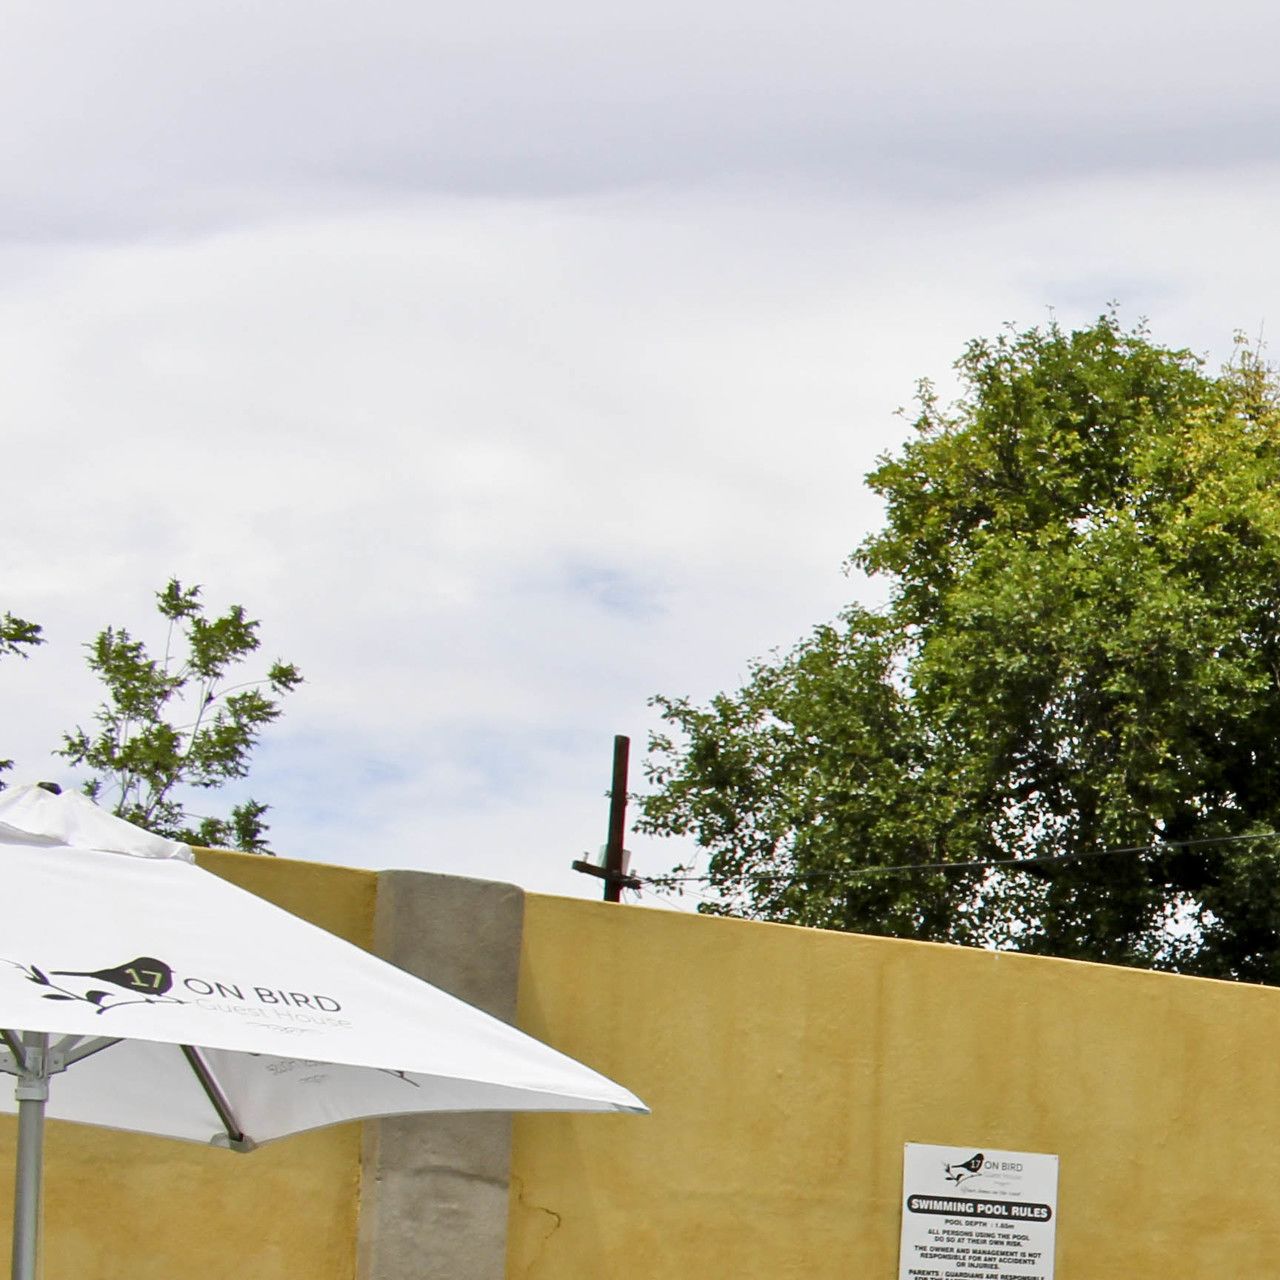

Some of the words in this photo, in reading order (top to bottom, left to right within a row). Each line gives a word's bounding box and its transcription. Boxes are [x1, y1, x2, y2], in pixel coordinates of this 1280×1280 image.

[124, 967, 164, 989] 17
[183, 978, 245, 1000] ON
[254, 986, 342, 1012] BIRD
[984, 1161, 999, 1170] ON
[1001, 1163, 1023, 1172] BIRD
[911, 1199, 974, 1213] SWIMMING
[977, 1203, 1008, 1216] POOL
[1011, 1207, 1048, 1218] RULES
[972, 1249, 1019, 1257] MANAGEMENT
[920, 1253, 966, 1261] RESPONSIBLE
[998, 1257, 1036, 1265] ACCIDENTS
[945, 1271, 984, 1279] GUARDIANS
